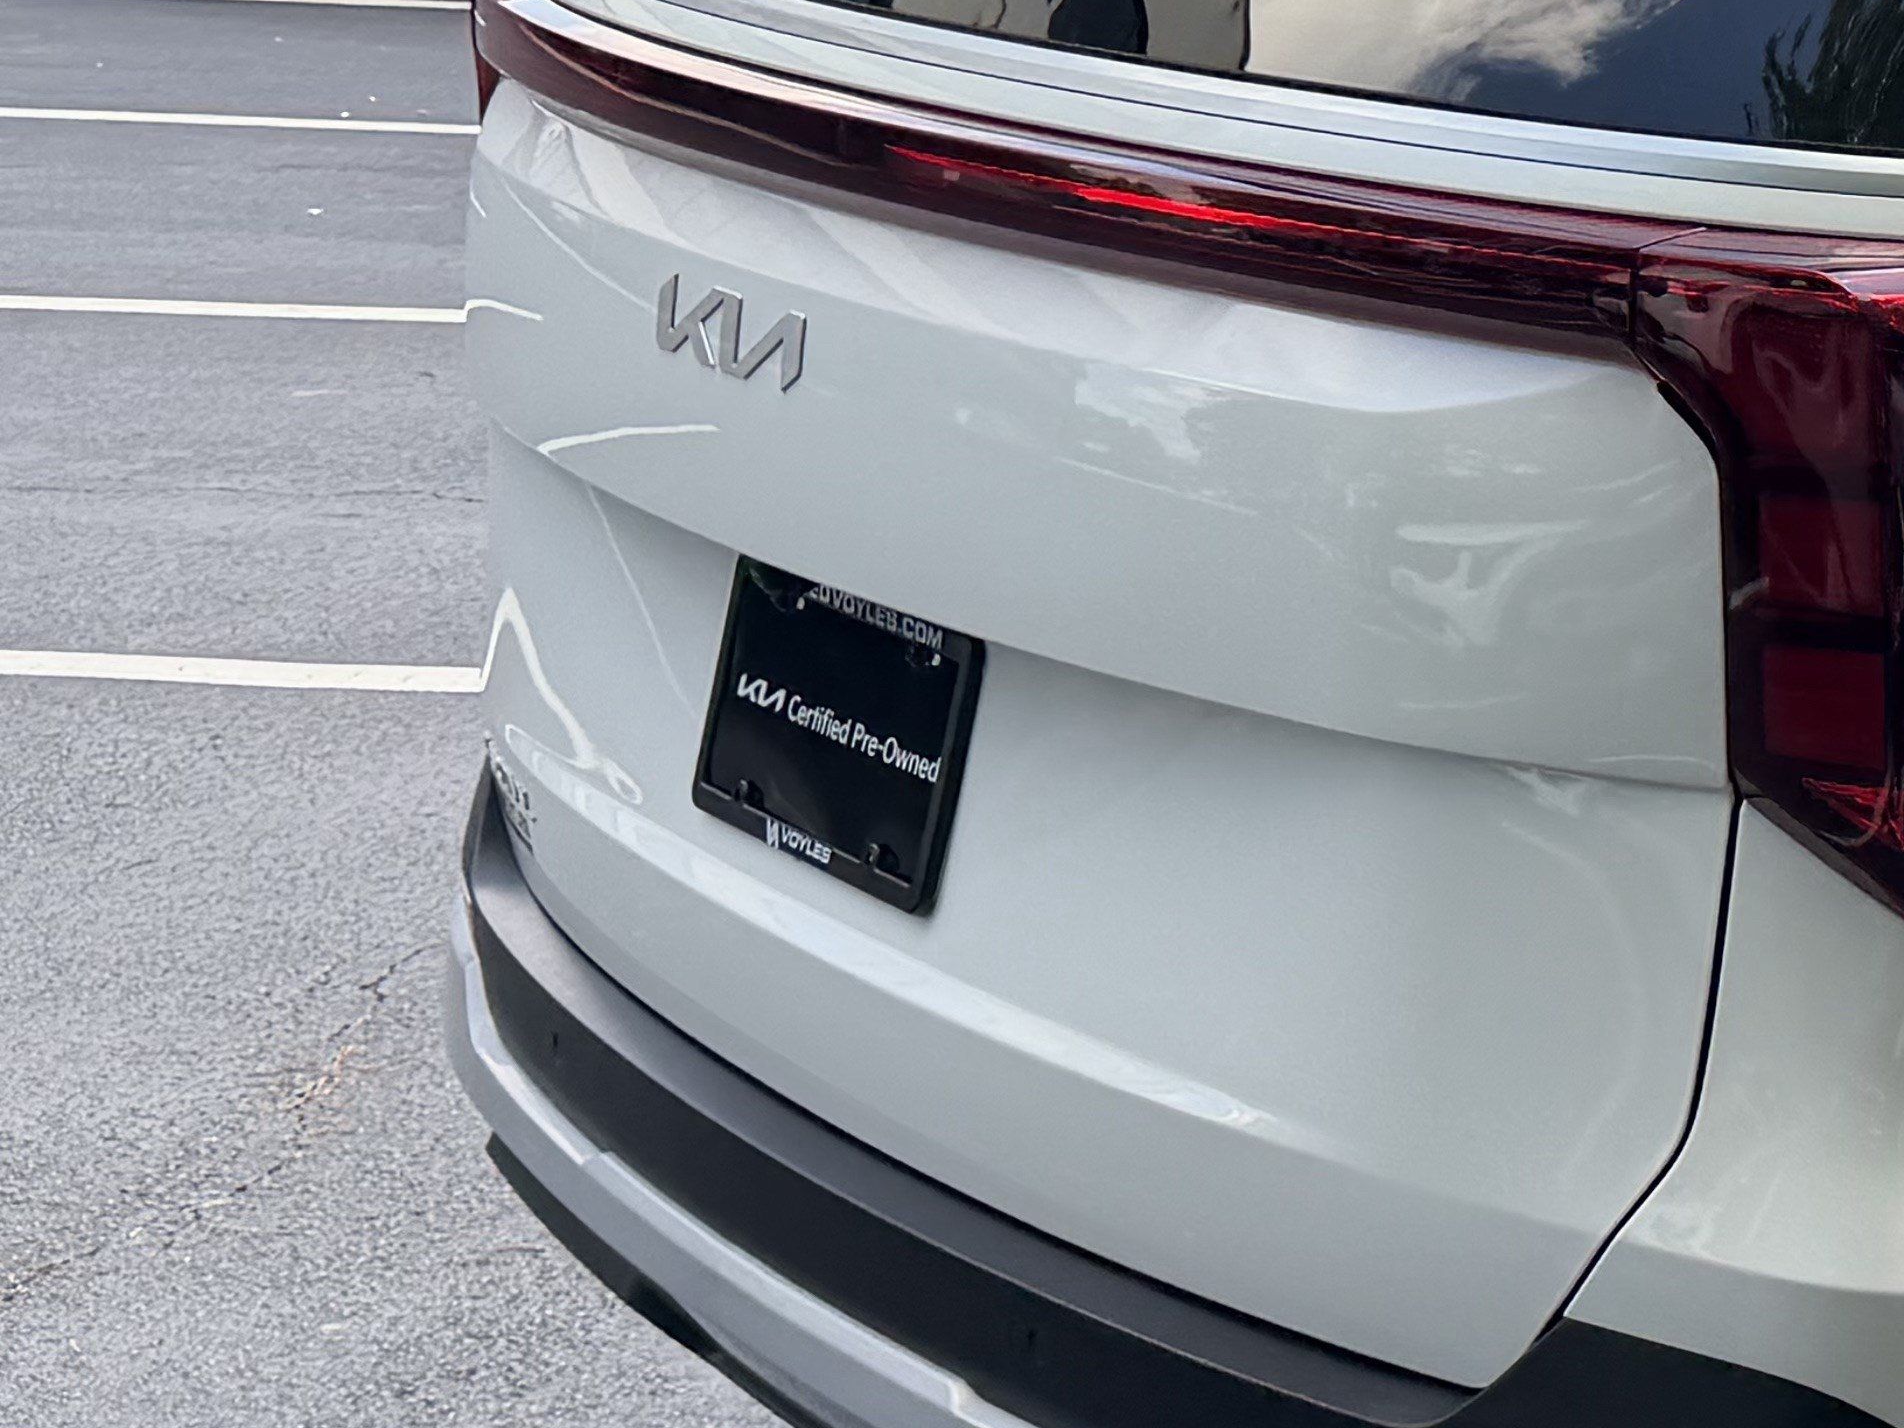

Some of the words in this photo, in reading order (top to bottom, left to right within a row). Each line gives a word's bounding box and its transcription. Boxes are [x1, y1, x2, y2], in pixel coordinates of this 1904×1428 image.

[656, 272, 808, 394] KIA
[736, 672, 788, 714] KIA
[787, 694, 853, 745] Certified
[850, 721, 942, 783] Pre-Owned
[781, 823, 832, 864] VOYLES
